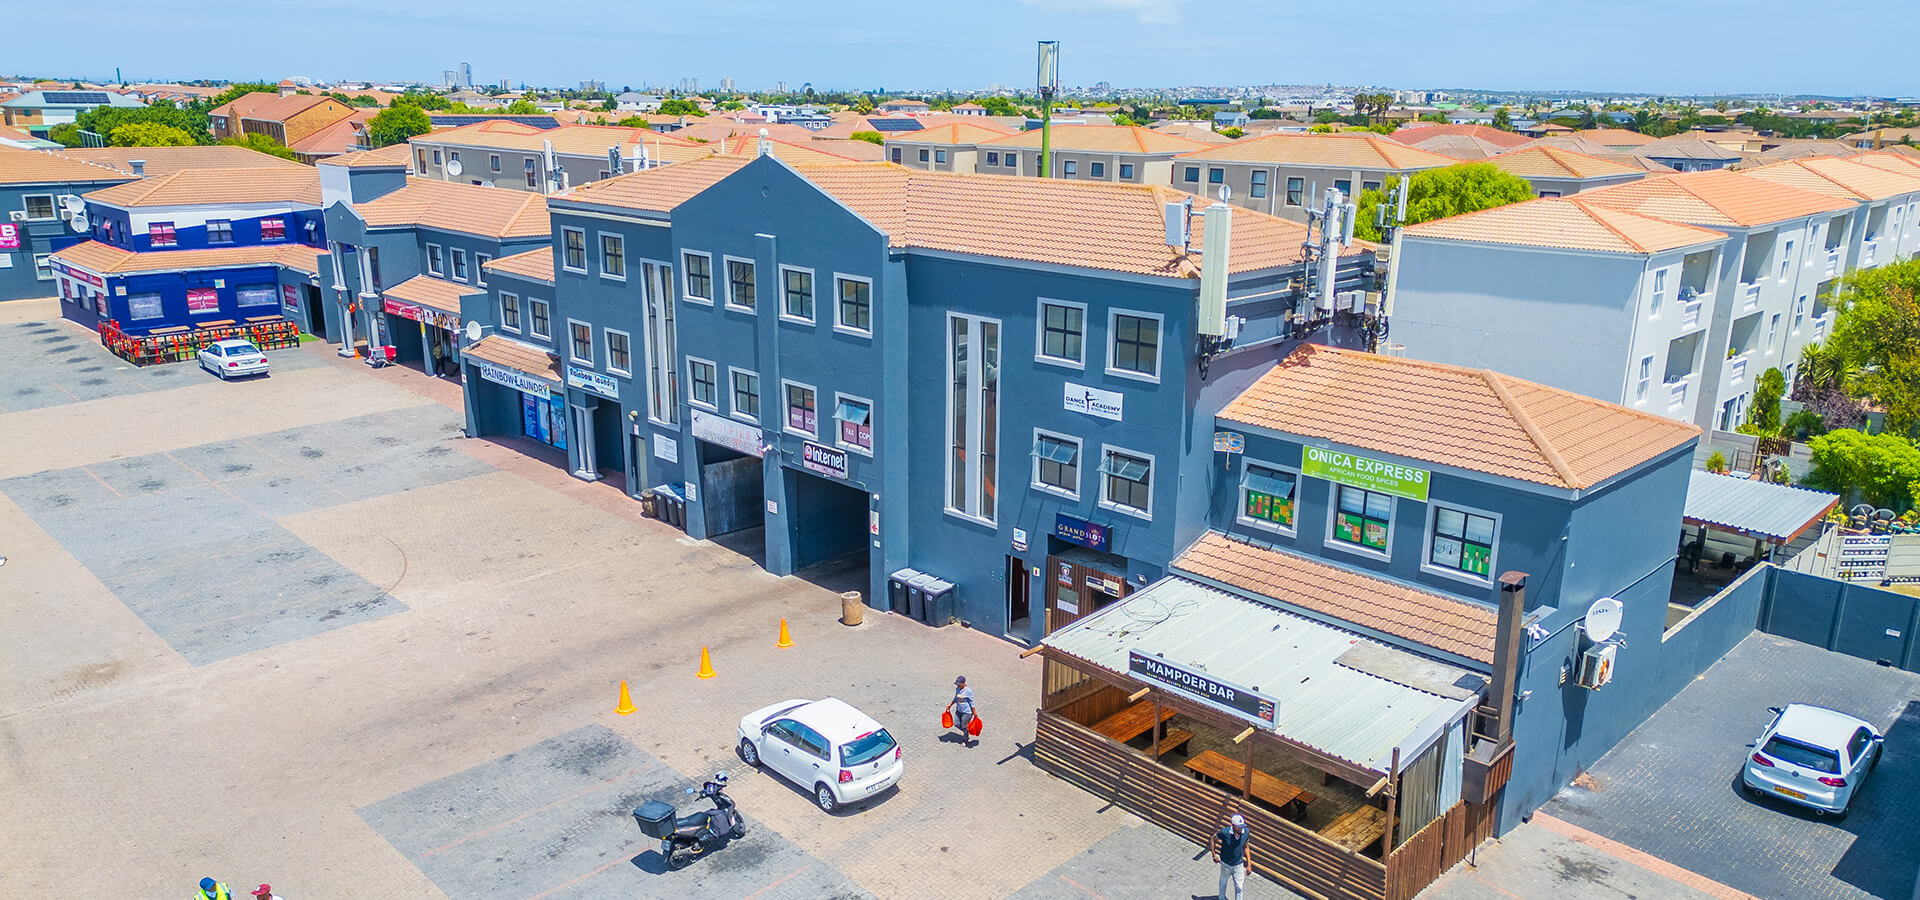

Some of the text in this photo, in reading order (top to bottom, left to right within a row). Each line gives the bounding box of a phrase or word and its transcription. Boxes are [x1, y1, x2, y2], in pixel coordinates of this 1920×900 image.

[482, 363, 550, 396] RAINBOW LAUNDRY
[569, 368, 592, 381] Rainbow
[1065, 396, 1085, 405] DANCE
[1091, 402, 1121, 411] ACADEMY
[1308, 448, 1424, 483] ONICA EXPRESS
[1329, 467, 1355, 477] AFRICAN
[1356, 472, 1374, 481] FOOD
[1376, 477, 1398, 487] SPICES
[1146, 660, 1207, 692] MAMPOER
[1209, 684, 1235, 701] BAR
